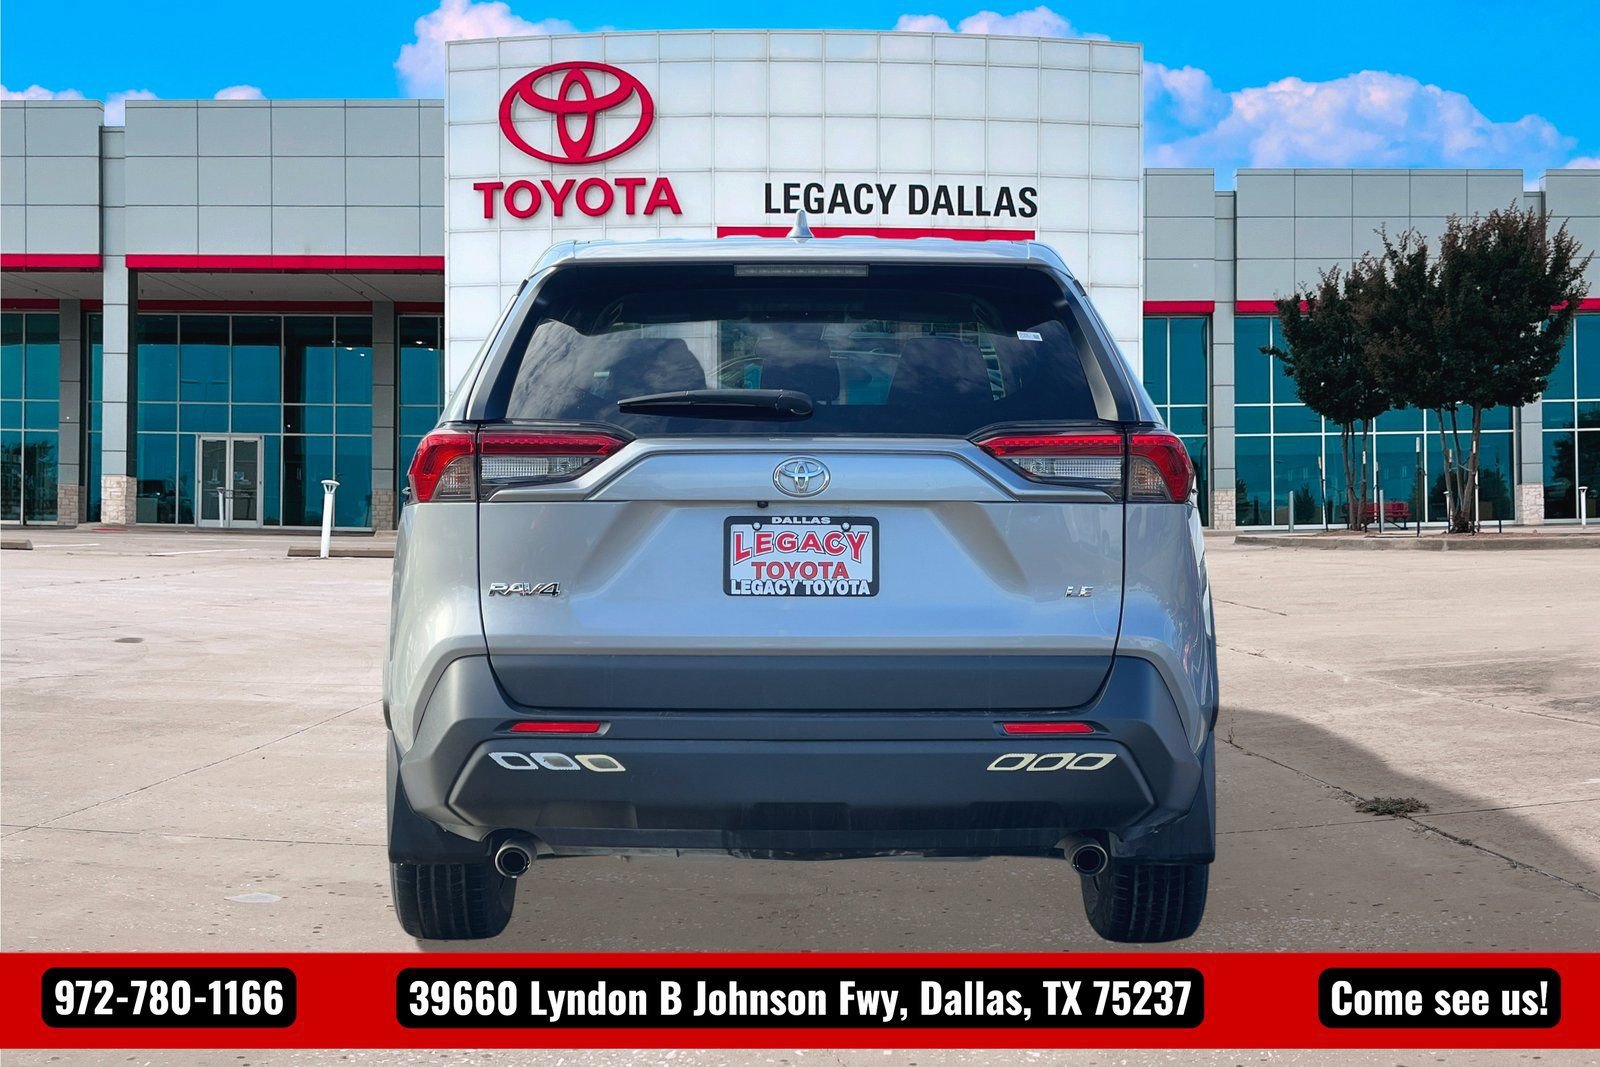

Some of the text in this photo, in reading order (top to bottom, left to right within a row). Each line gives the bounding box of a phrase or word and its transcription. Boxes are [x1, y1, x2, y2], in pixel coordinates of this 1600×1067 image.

[473, 177, 682, 219] TOYOTA
[764, 182, 1038, 217] LEGACY DALLAS
[771, 516, 831, 524] DALLAS
[733, 530, 869, 566] LEGACY
[751, 561, 849, 579] TOYOTA
[488, 581, 561, 597] RAV4
[731, 579, 870, 596] LEGACY TOYOTA
[1064, 585, 1094, 598] LE
